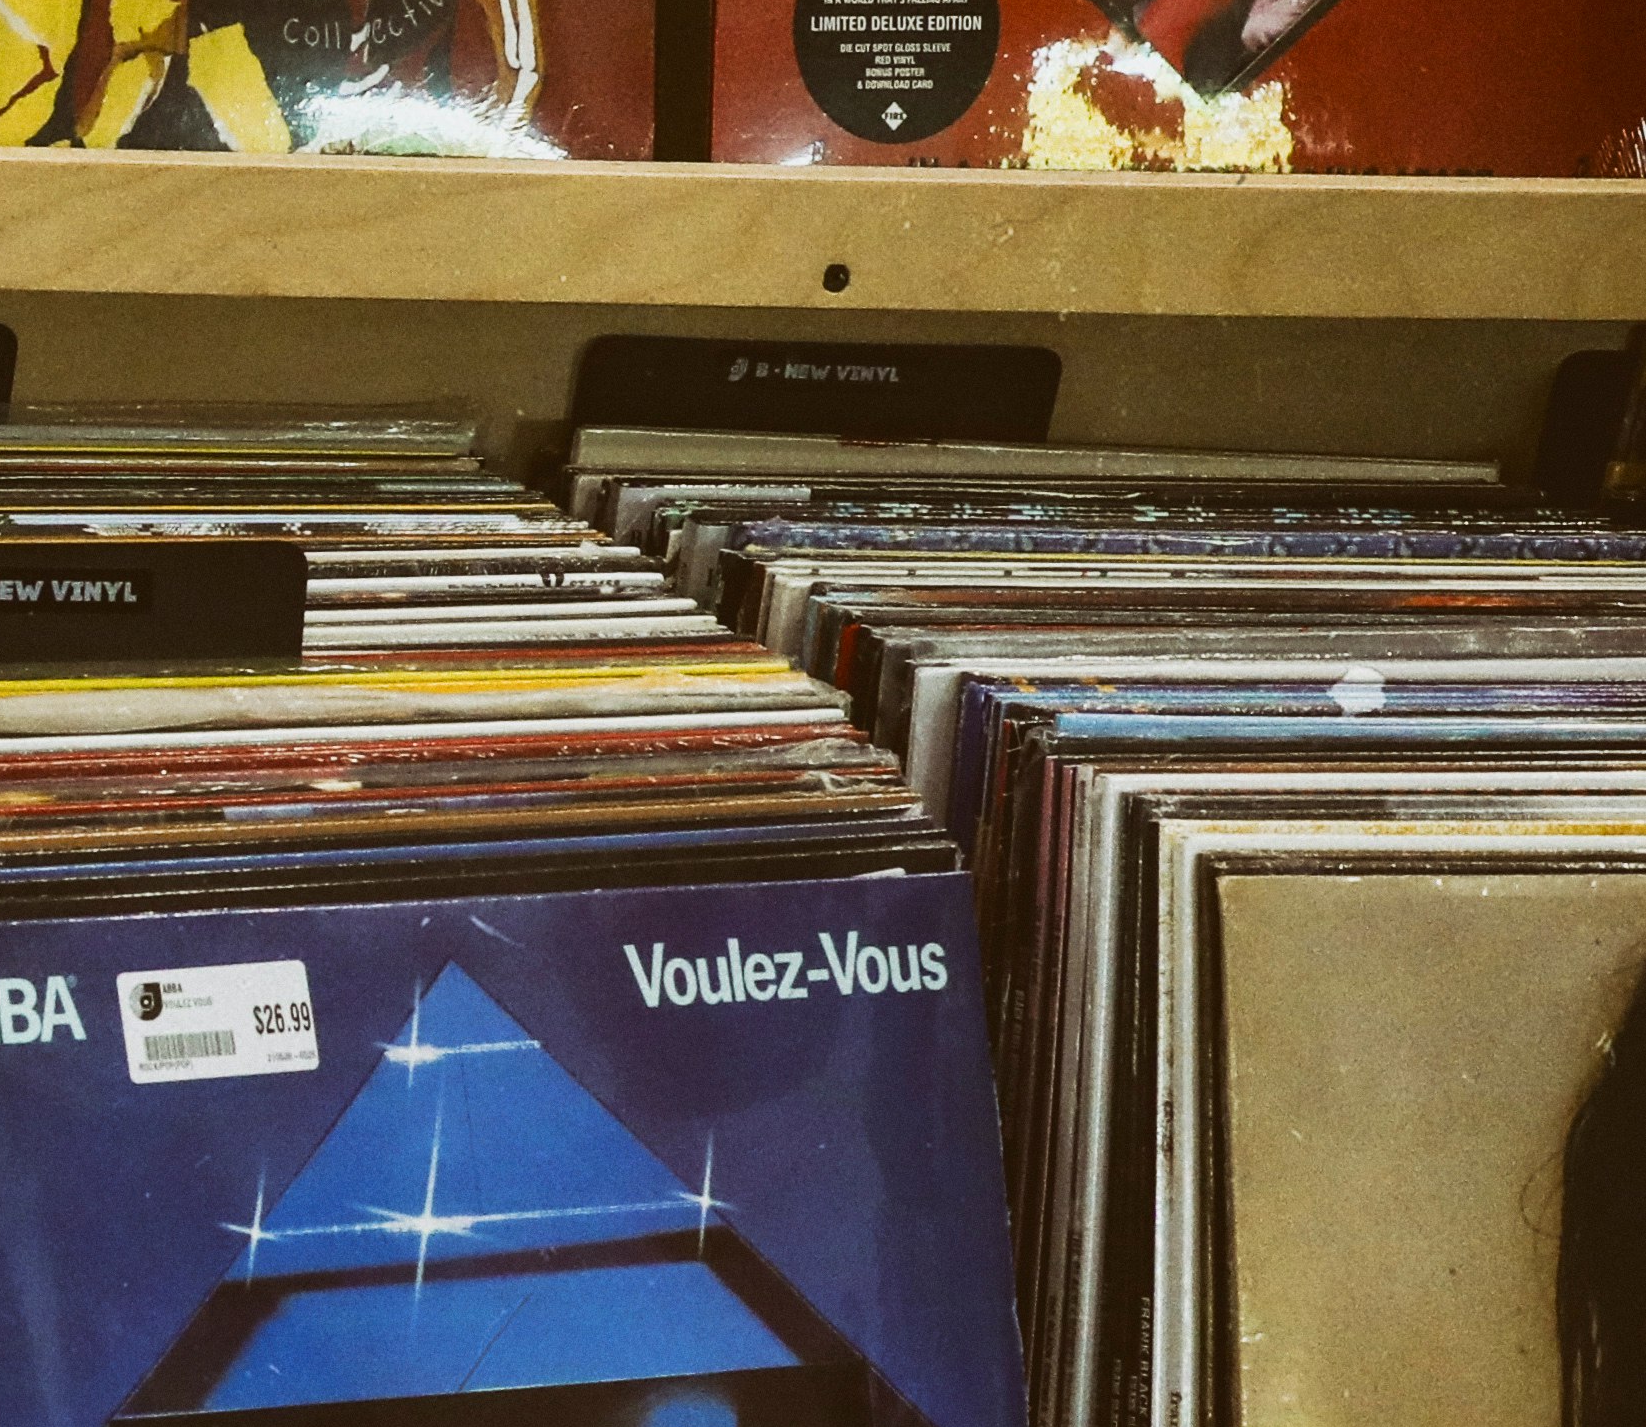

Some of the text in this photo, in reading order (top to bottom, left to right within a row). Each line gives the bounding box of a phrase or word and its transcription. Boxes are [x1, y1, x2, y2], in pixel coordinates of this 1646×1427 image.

[811, 16, 982, 31] LIMITED DELUXE EDITION
[840, 43, 951, 53] DIE CUT SPOT GLOSS SLEEVE
[875, 56, 915, 65] RED VINYL
[50, 579, 139, 604] VINYL
[623, 930, 950, 1010] Voulez-Vous
[253, 1002, 311, 1034] $26.99
